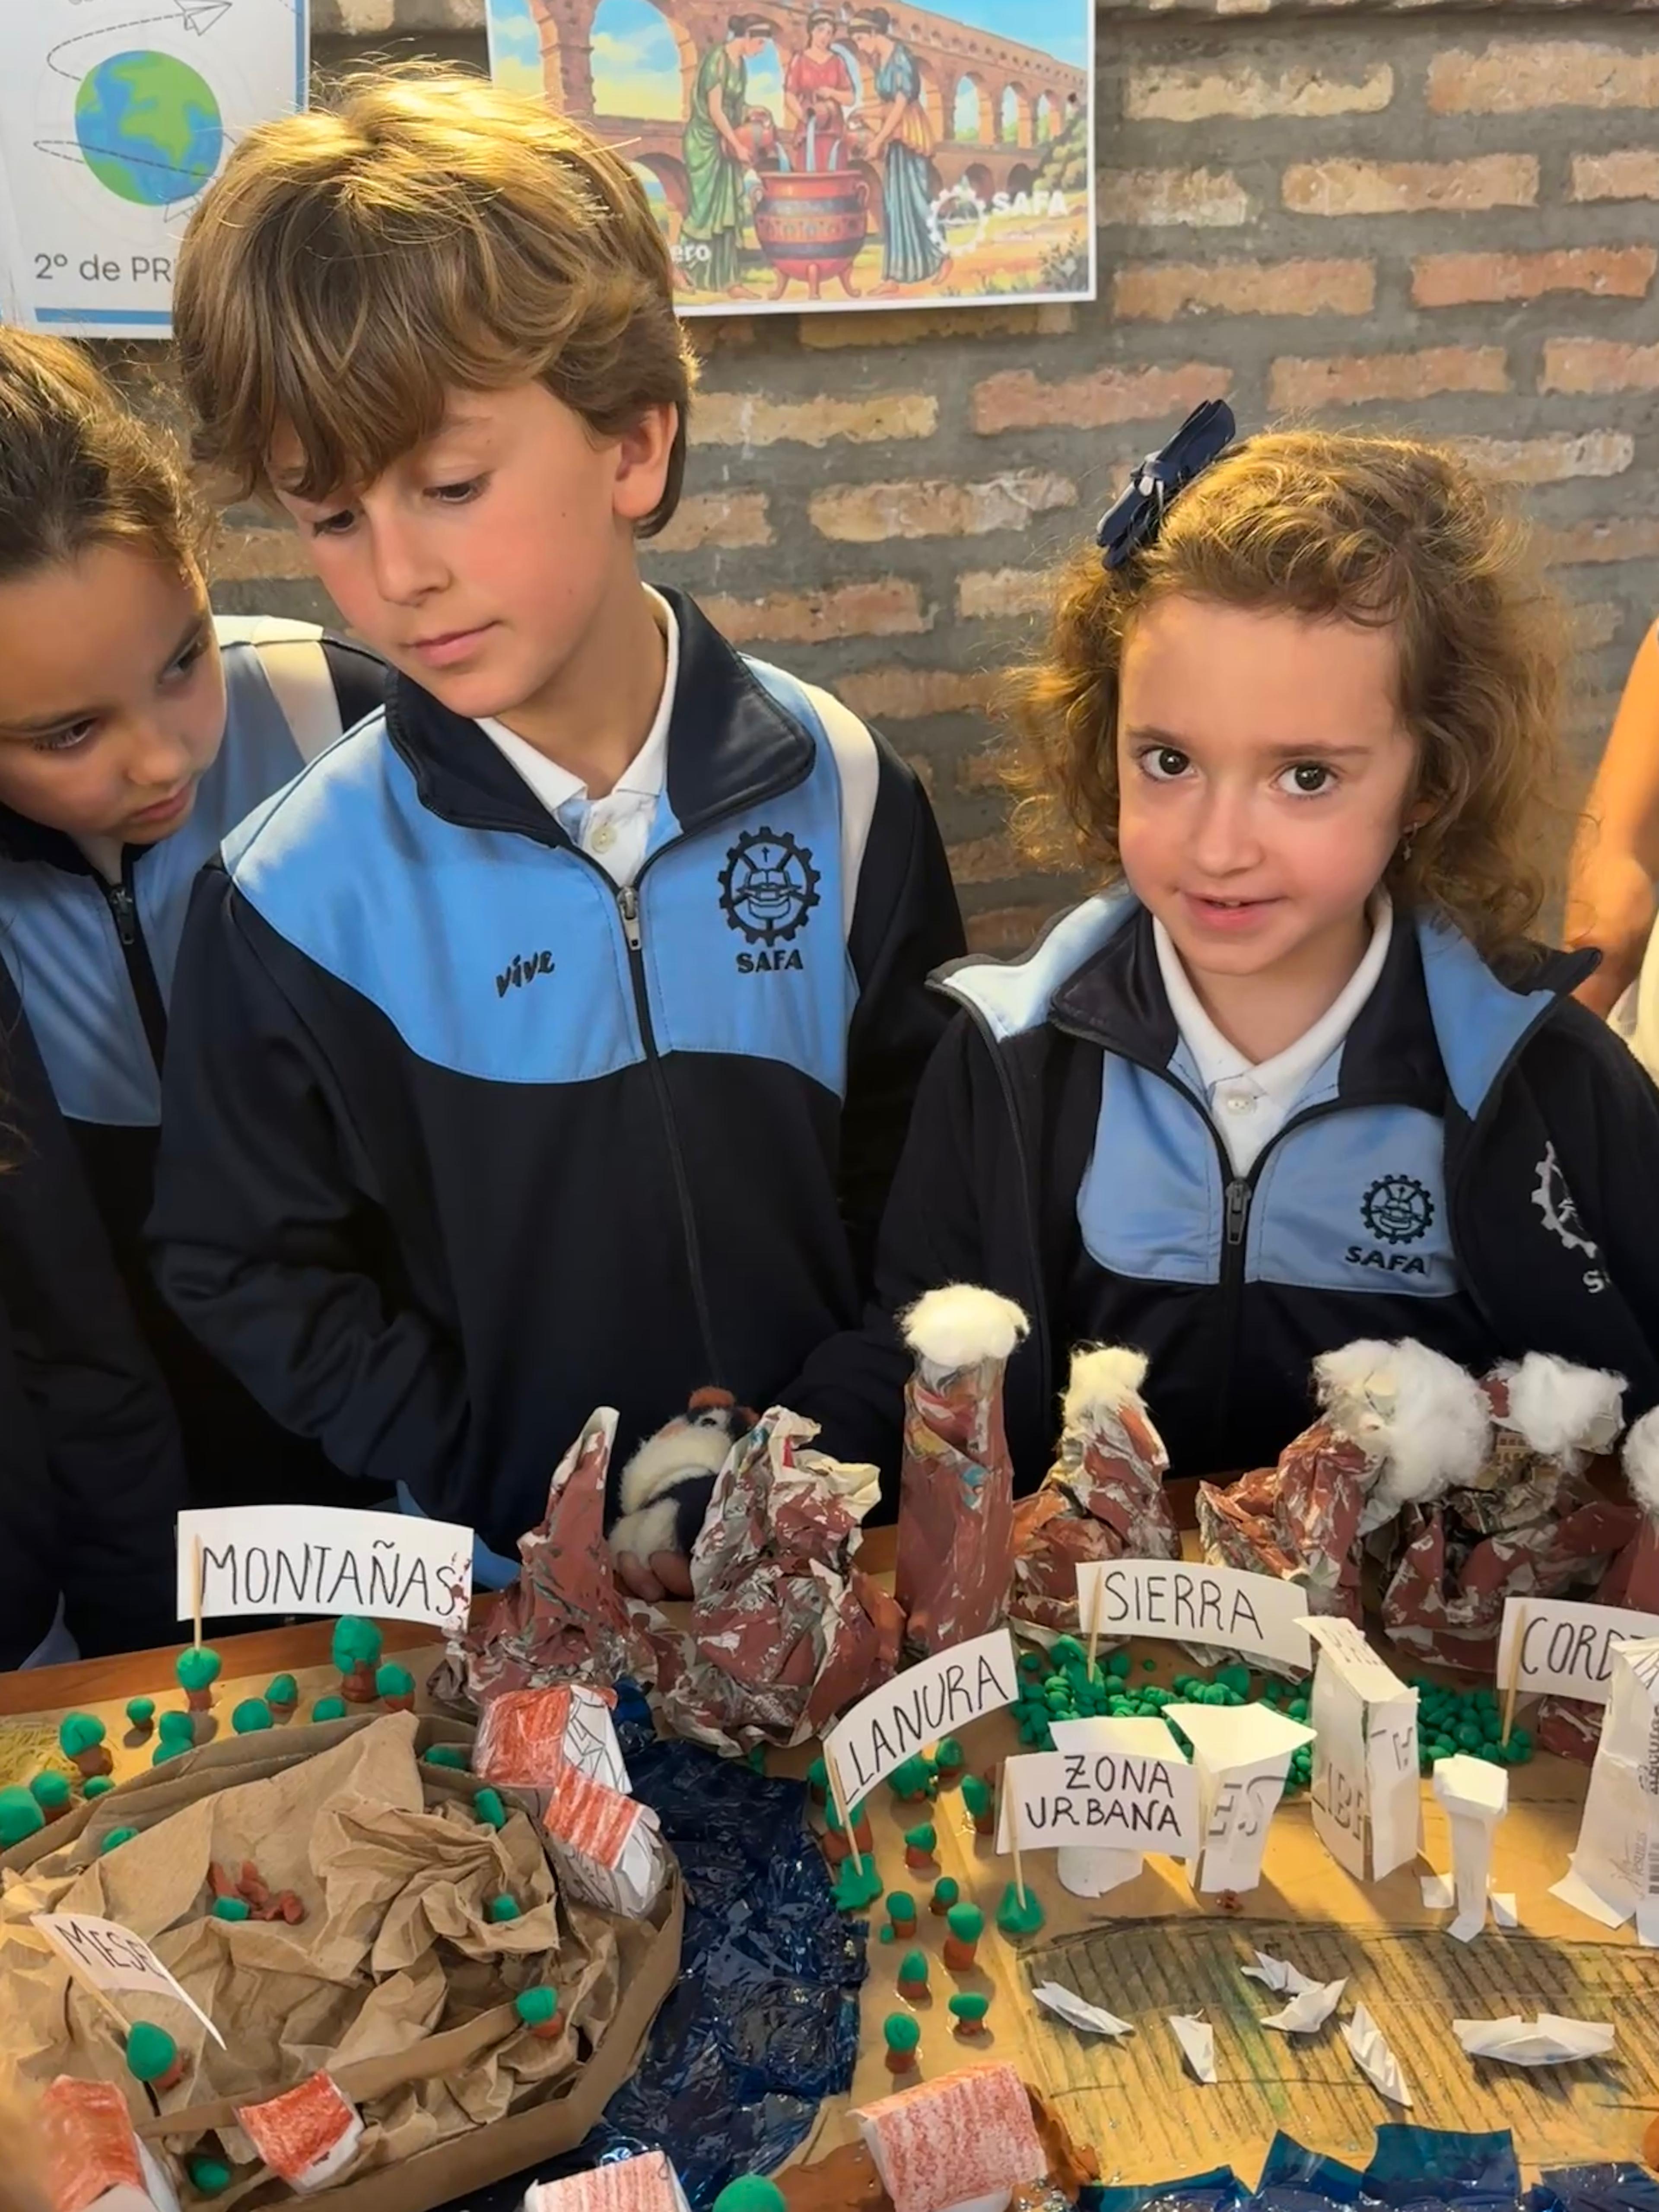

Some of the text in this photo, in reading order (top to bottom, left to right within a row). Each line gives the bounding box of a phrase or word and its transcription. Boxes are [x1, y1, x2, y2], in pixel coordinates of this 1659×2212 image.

[992, 190, 1068, 217] SAFA
[79, 254, 121, 281] de
[736, 949, 804, 973] SAFA
[1345, 1246, 1426, 1274] SAFA
[201, 1540, 456, 1616] MONTAÑAS
[1104, 1571, 1264, 1640] SIERRA
[1520, 1617, 1645, 1681] CORD
[1063, 1755, 1174, 1798] ZONA
[1024, 1797, 1182, 1837] URBANA
